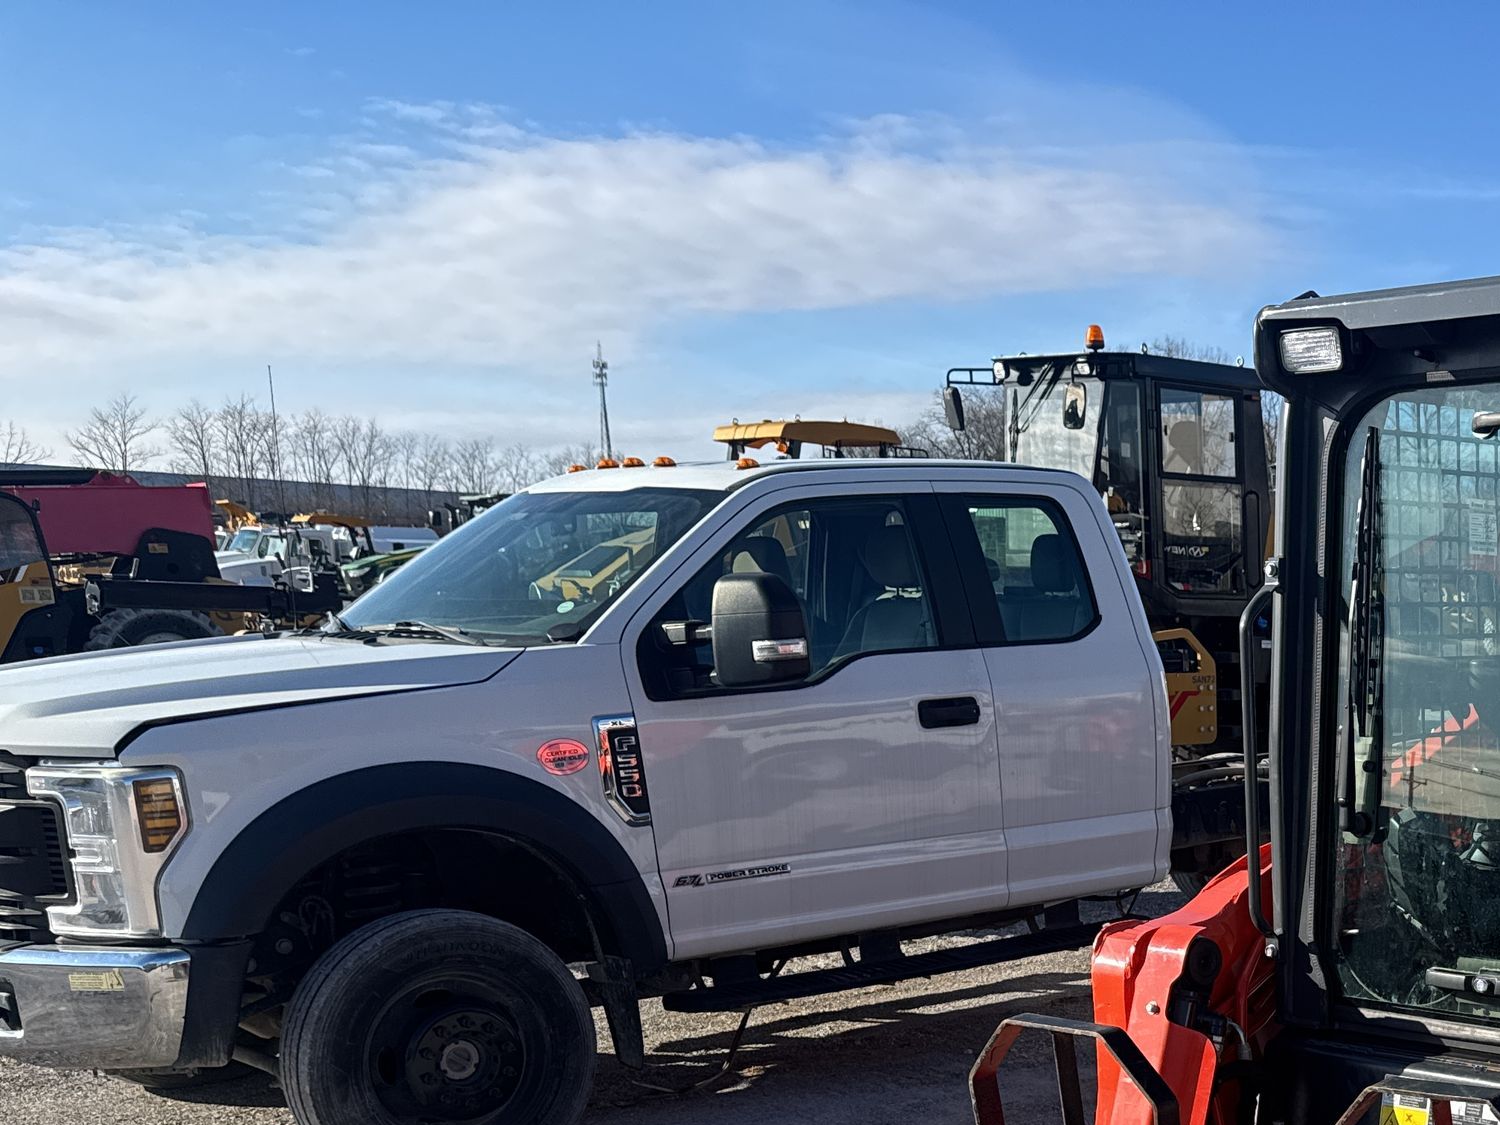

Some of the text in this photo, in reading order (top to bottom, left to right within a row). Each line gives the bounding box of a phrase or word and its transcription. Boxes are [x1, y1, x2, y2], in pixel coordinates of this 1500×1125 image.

[546, 749, 579, 757] CERTIFIED
[709, 870, 746, 880] POWER
[748, 863, 788, 874] STROKE
